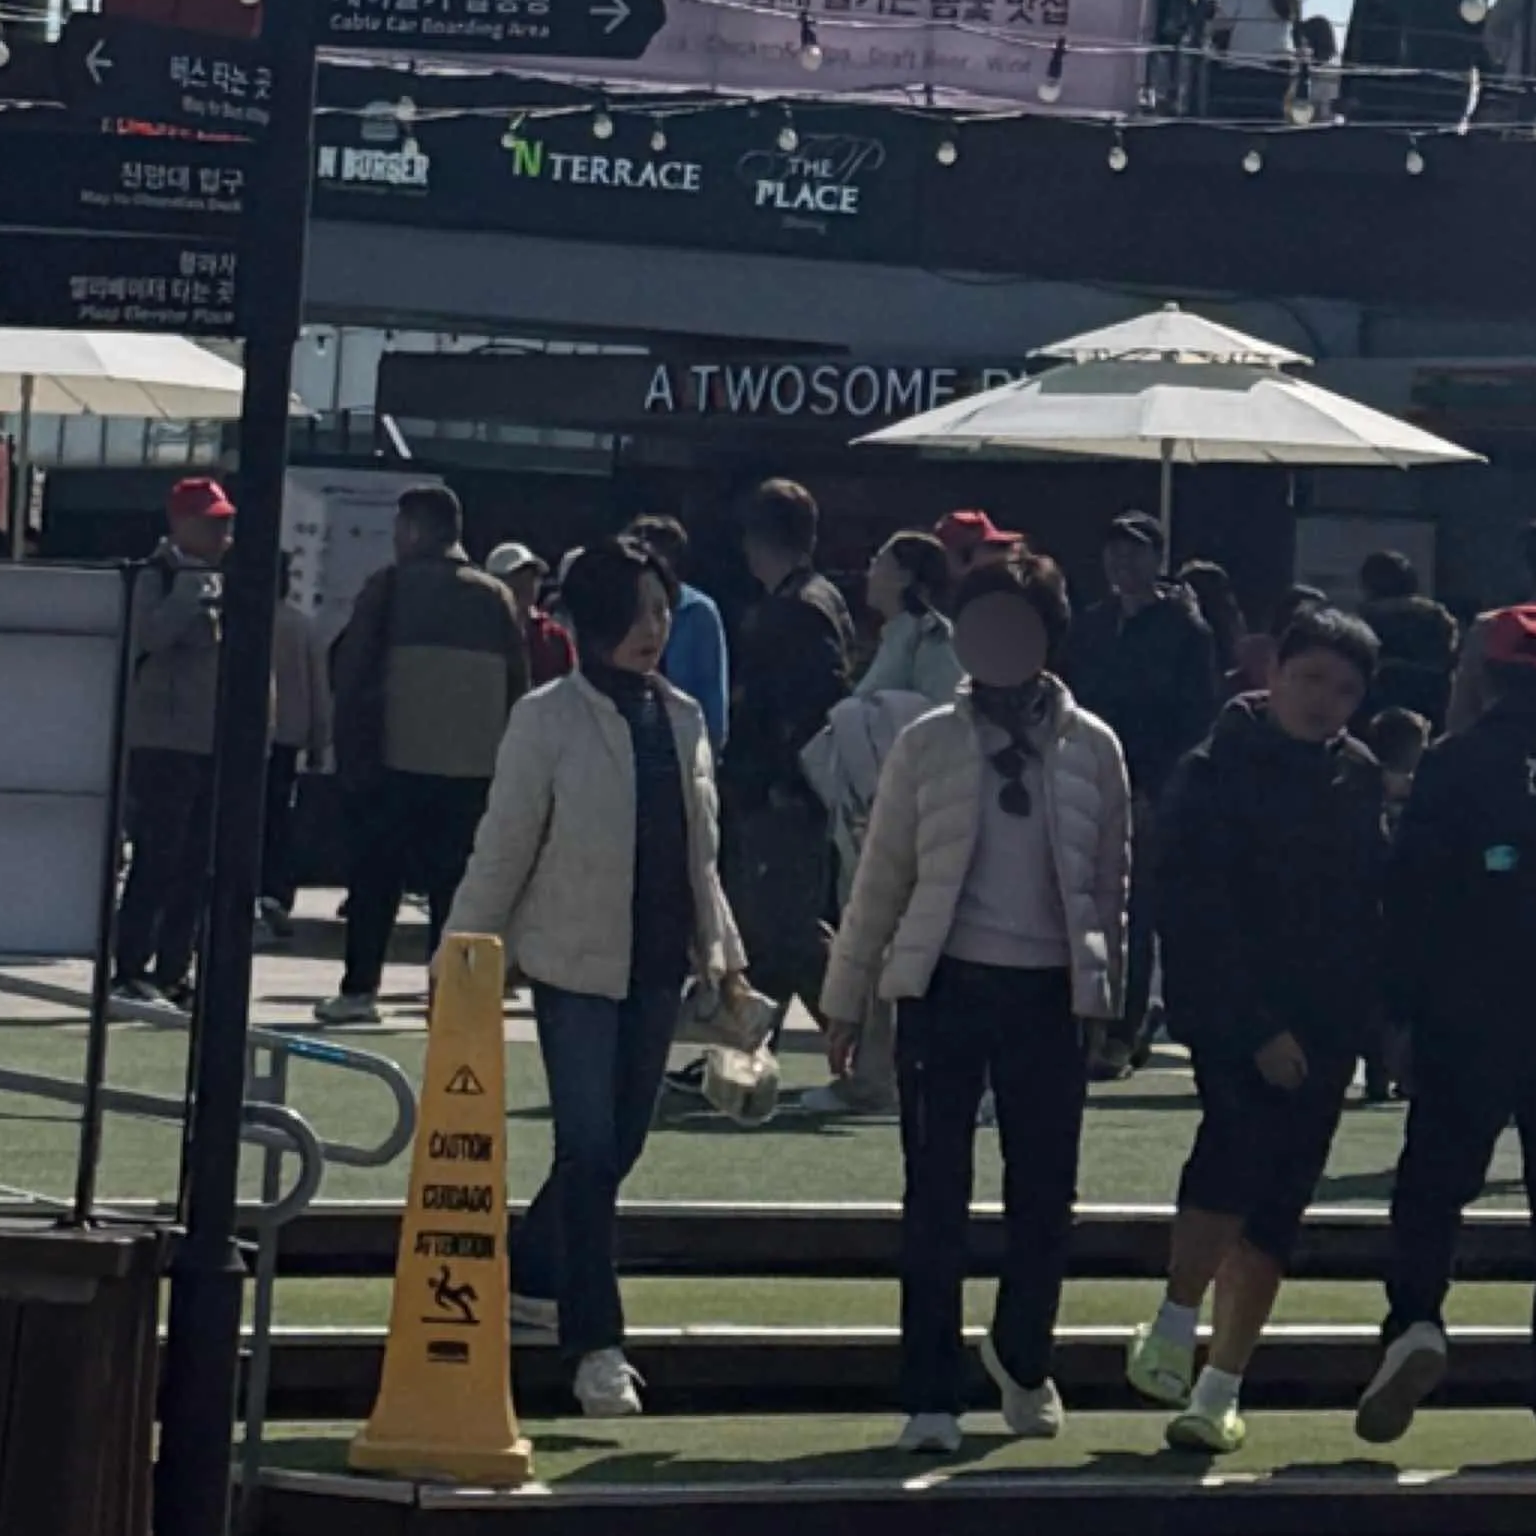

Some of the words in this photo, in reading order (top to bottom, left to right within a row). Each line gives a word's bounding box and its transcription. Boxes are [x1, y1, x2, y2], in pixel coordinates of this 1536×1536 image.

[341, 146, 430, 185] BURGER
[512, 139, 543, 178] N
[549, 152, 703, 190] TERRACE
[787, 158, 834, 178] THE
[755, 179, 861, 215] PLACE
[644, 363, 674, 413] A
[690, 364, 958, 416] TWOSOME
[429, 1130, 493, 1161] CAUTION
[421, 1184, 493, 1215] CUIDADO
